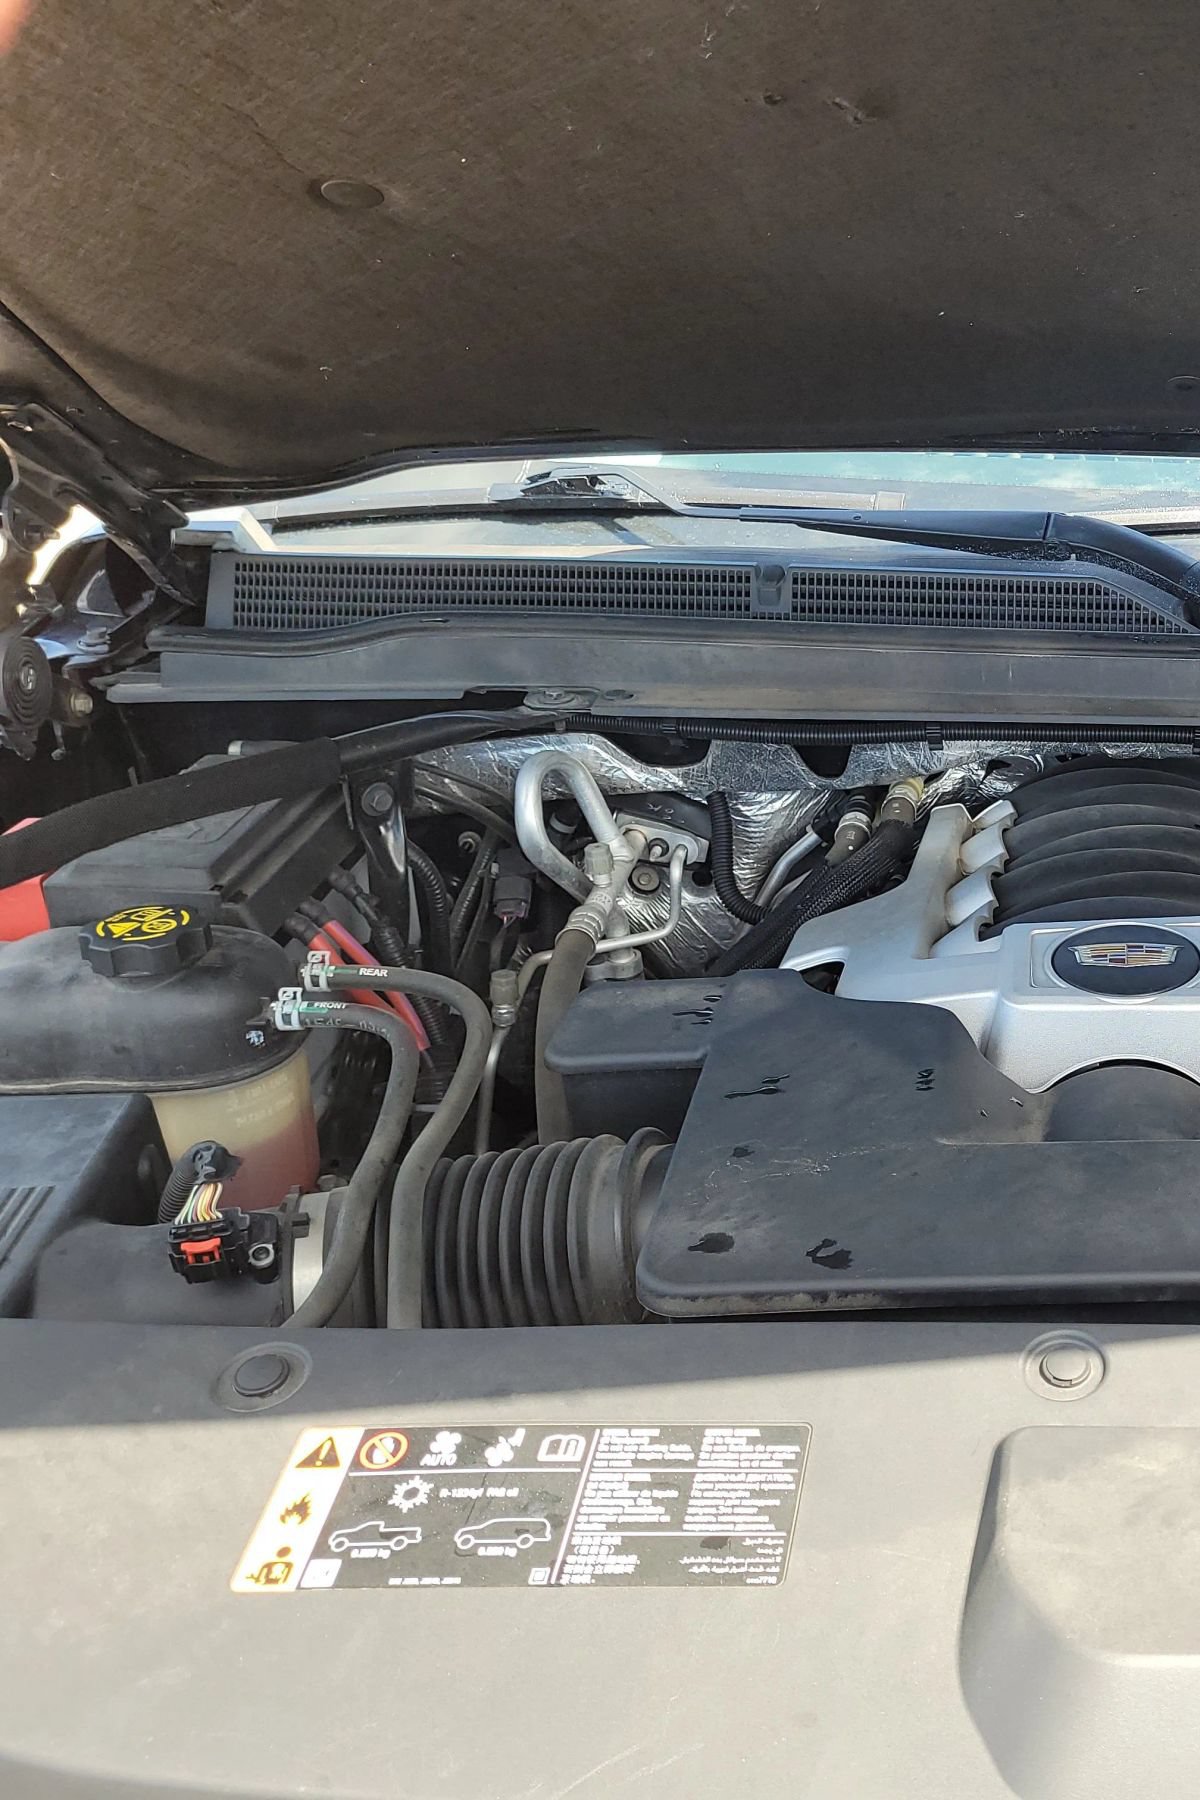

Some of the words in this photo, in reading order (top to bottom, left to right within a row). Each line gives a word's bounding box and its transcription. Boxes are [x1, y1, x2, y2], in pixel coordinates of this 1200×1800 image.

[359, 967, 388, 977] REAR
[314, 1000, 347, 1010] FRONT
[420, 1453, 457, 1466] AUTO
